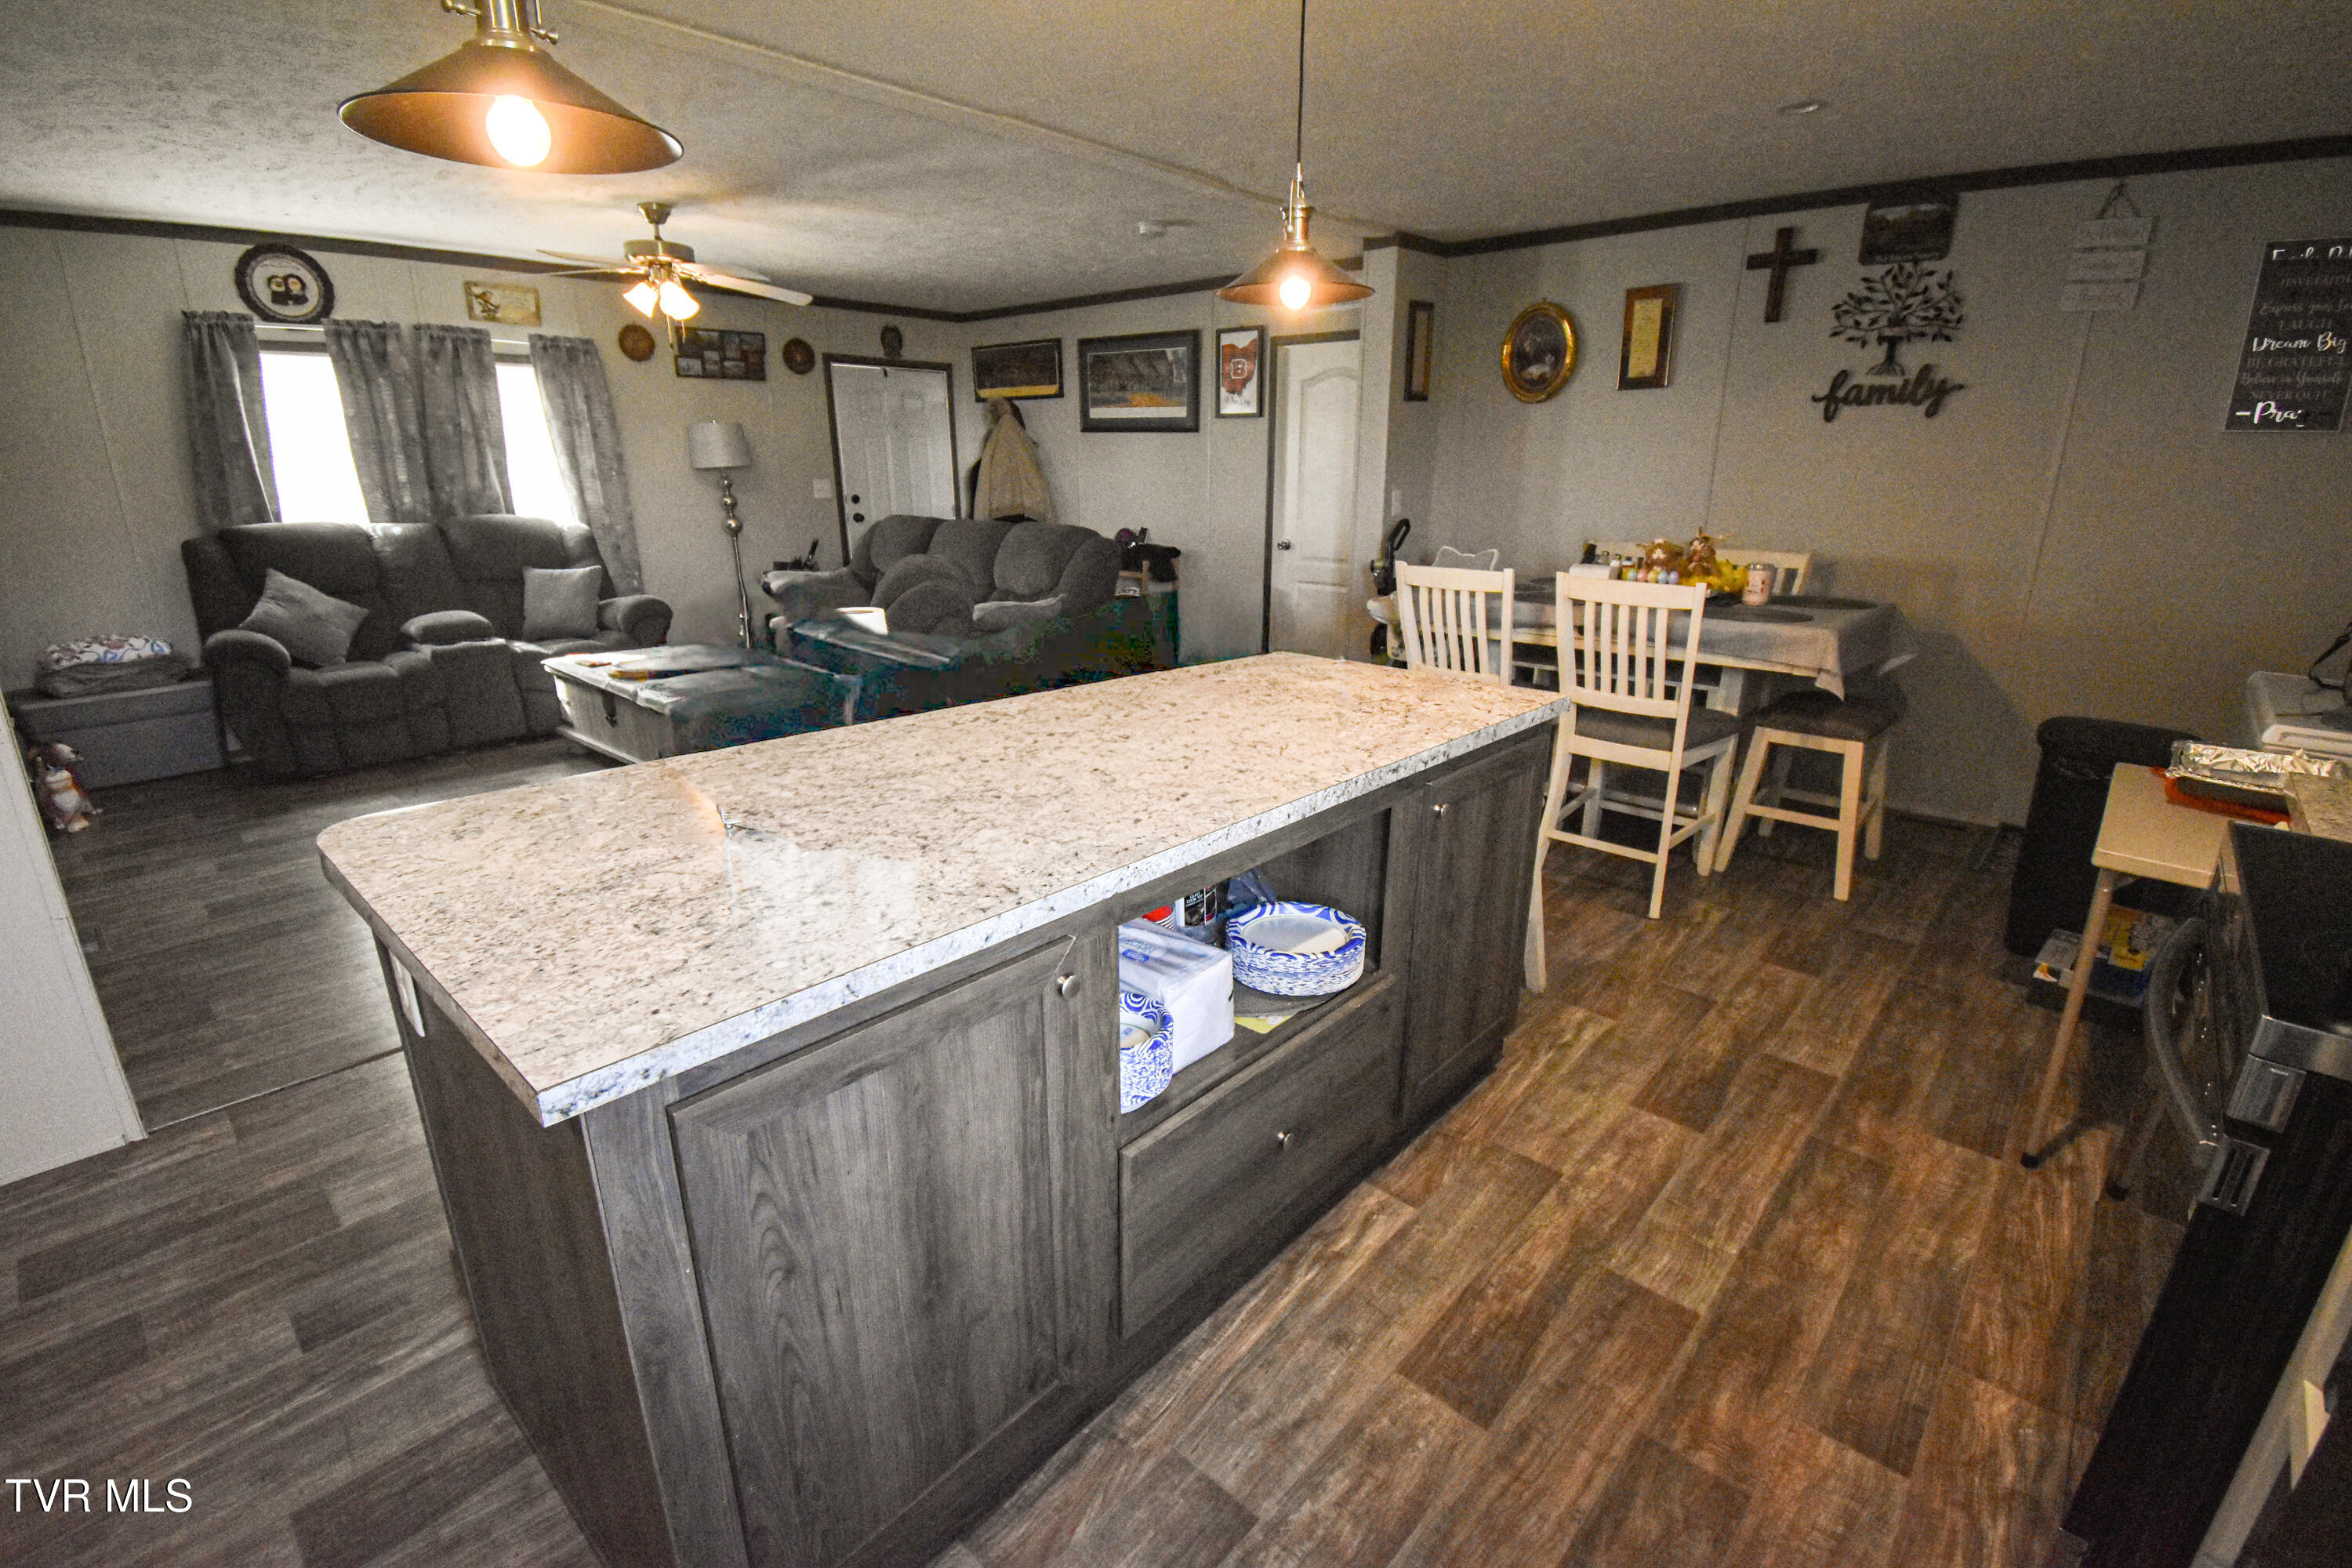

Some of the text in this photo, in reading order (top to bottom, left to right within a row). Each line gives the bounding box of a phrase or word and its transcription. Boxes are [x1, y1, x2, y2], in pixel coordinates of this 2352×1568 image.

[2252, 331, 2347, 354] Dream Big
[1811, 363, 1965, 423] family
[2251, 390, 2293, 401] NEVER
